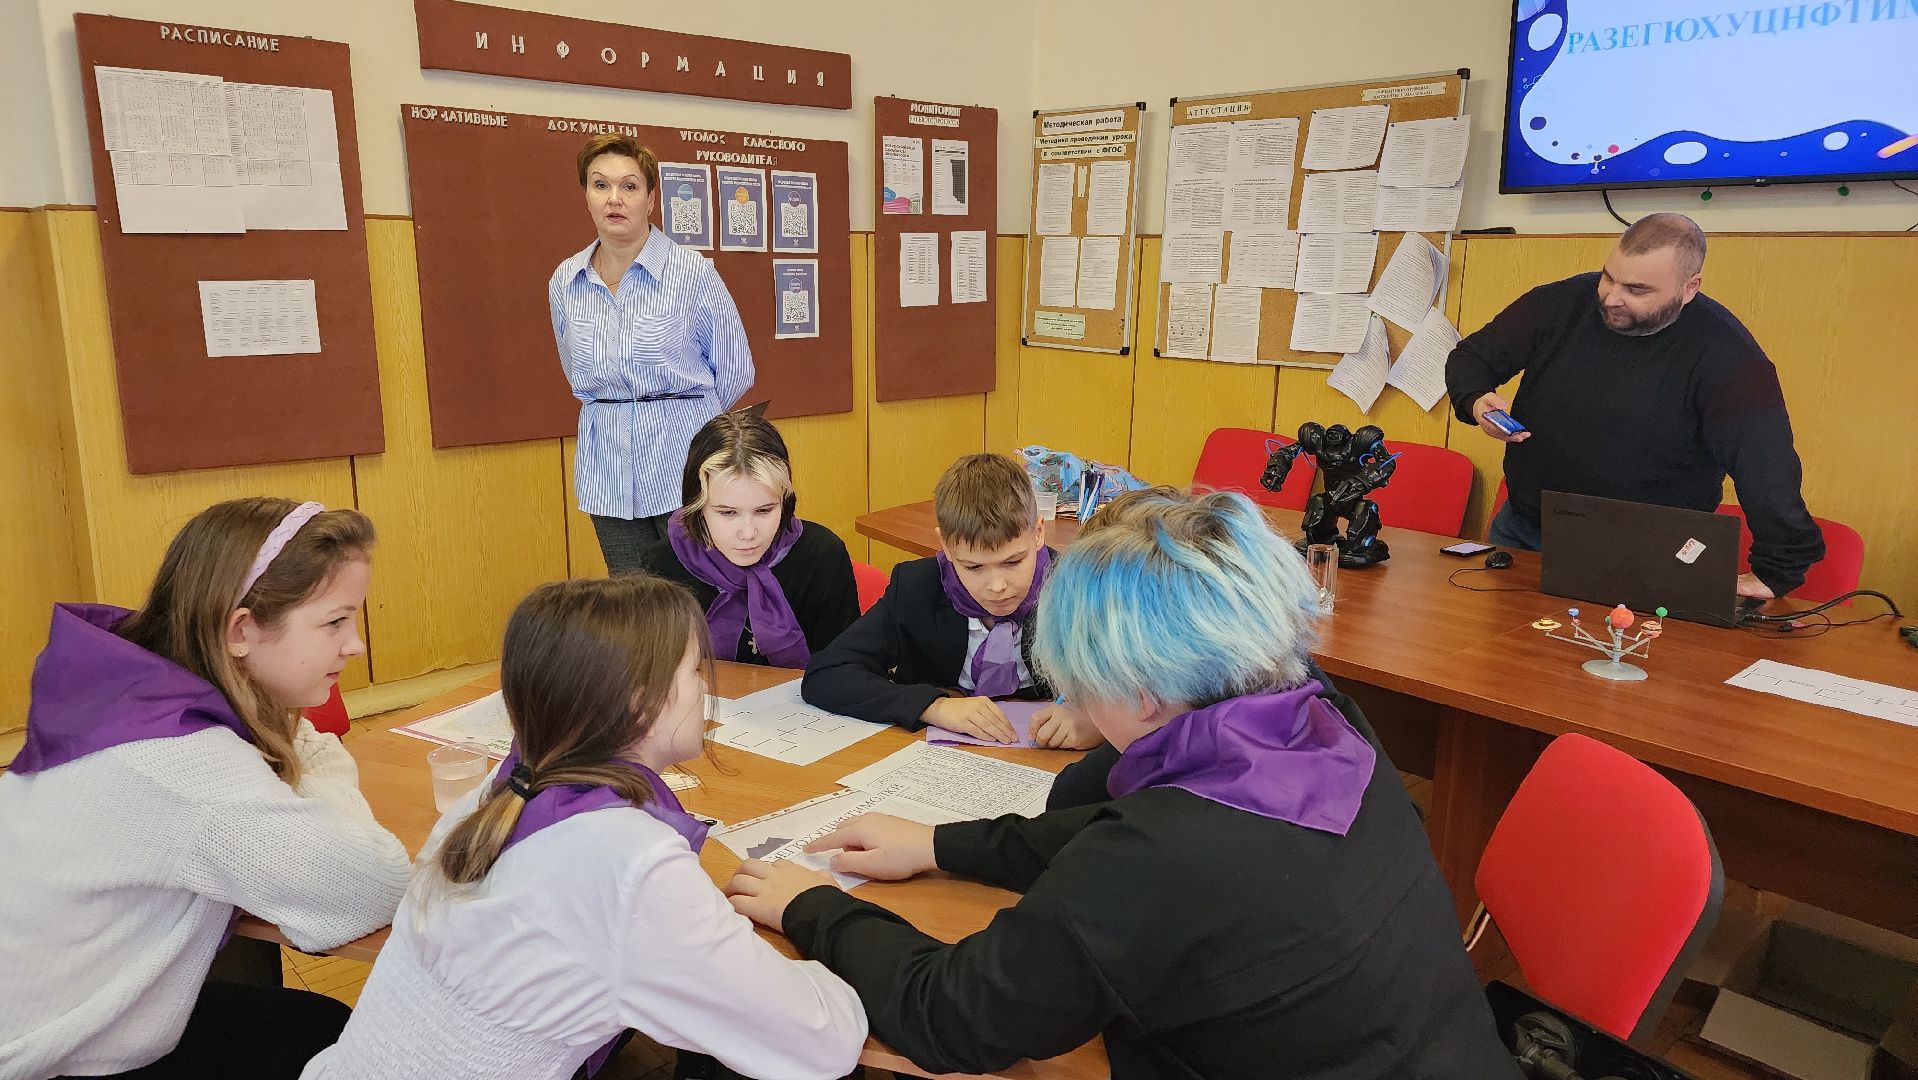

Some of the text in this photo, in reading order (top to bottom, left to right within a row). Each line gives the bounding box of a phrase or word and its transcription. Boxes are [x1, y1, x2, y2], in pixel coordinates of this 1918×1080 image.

[160, 25, 280, 52] РАСПИСАНИЕ
[475, 31, 825, 87] ИНФОРМАЦИЯ
[1187, 104, 1250, 117] АТТЕСТАЦИЯ
[1043, 115, 1122, 129] Методическая работа
[743, 136, 806, 152] КЛАССНОГО
[1039, 137, 1069, 145] Методика
[1112, 133, 1133, 142] урока
[1101, 145, 1123, 153] ФГОС
[696, 150, 778, 166] РУКОВОДИТЕЛЯ
